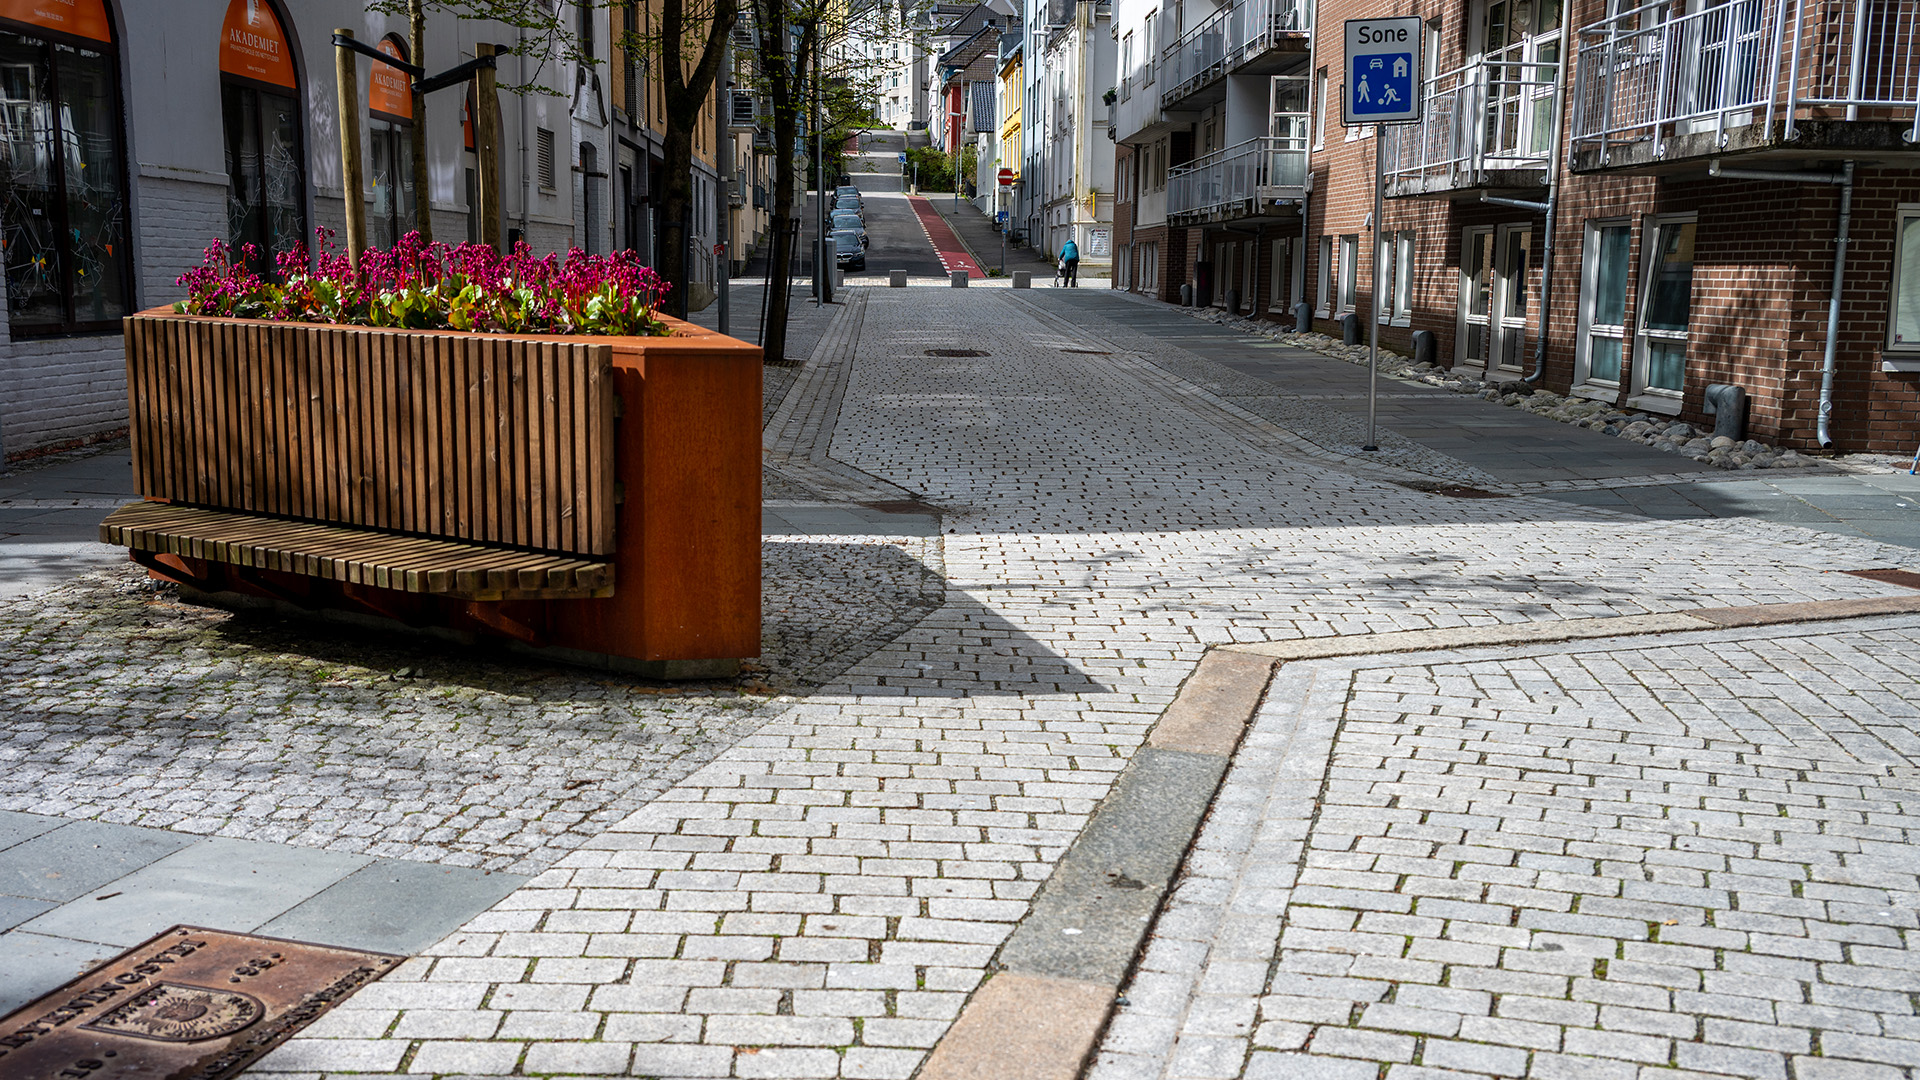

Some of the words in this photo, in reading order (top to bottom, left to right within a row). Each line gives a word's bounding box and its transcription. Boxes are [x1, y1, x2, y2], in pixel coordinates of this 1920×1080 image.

[229, 28, 279, 54] AKADEMIET
[1357, 25, 1409, 45] Sone
[374, 72, 406, 92] AKADEMIET
[0, 938, 207, 1057] RYKNINGSVEI
